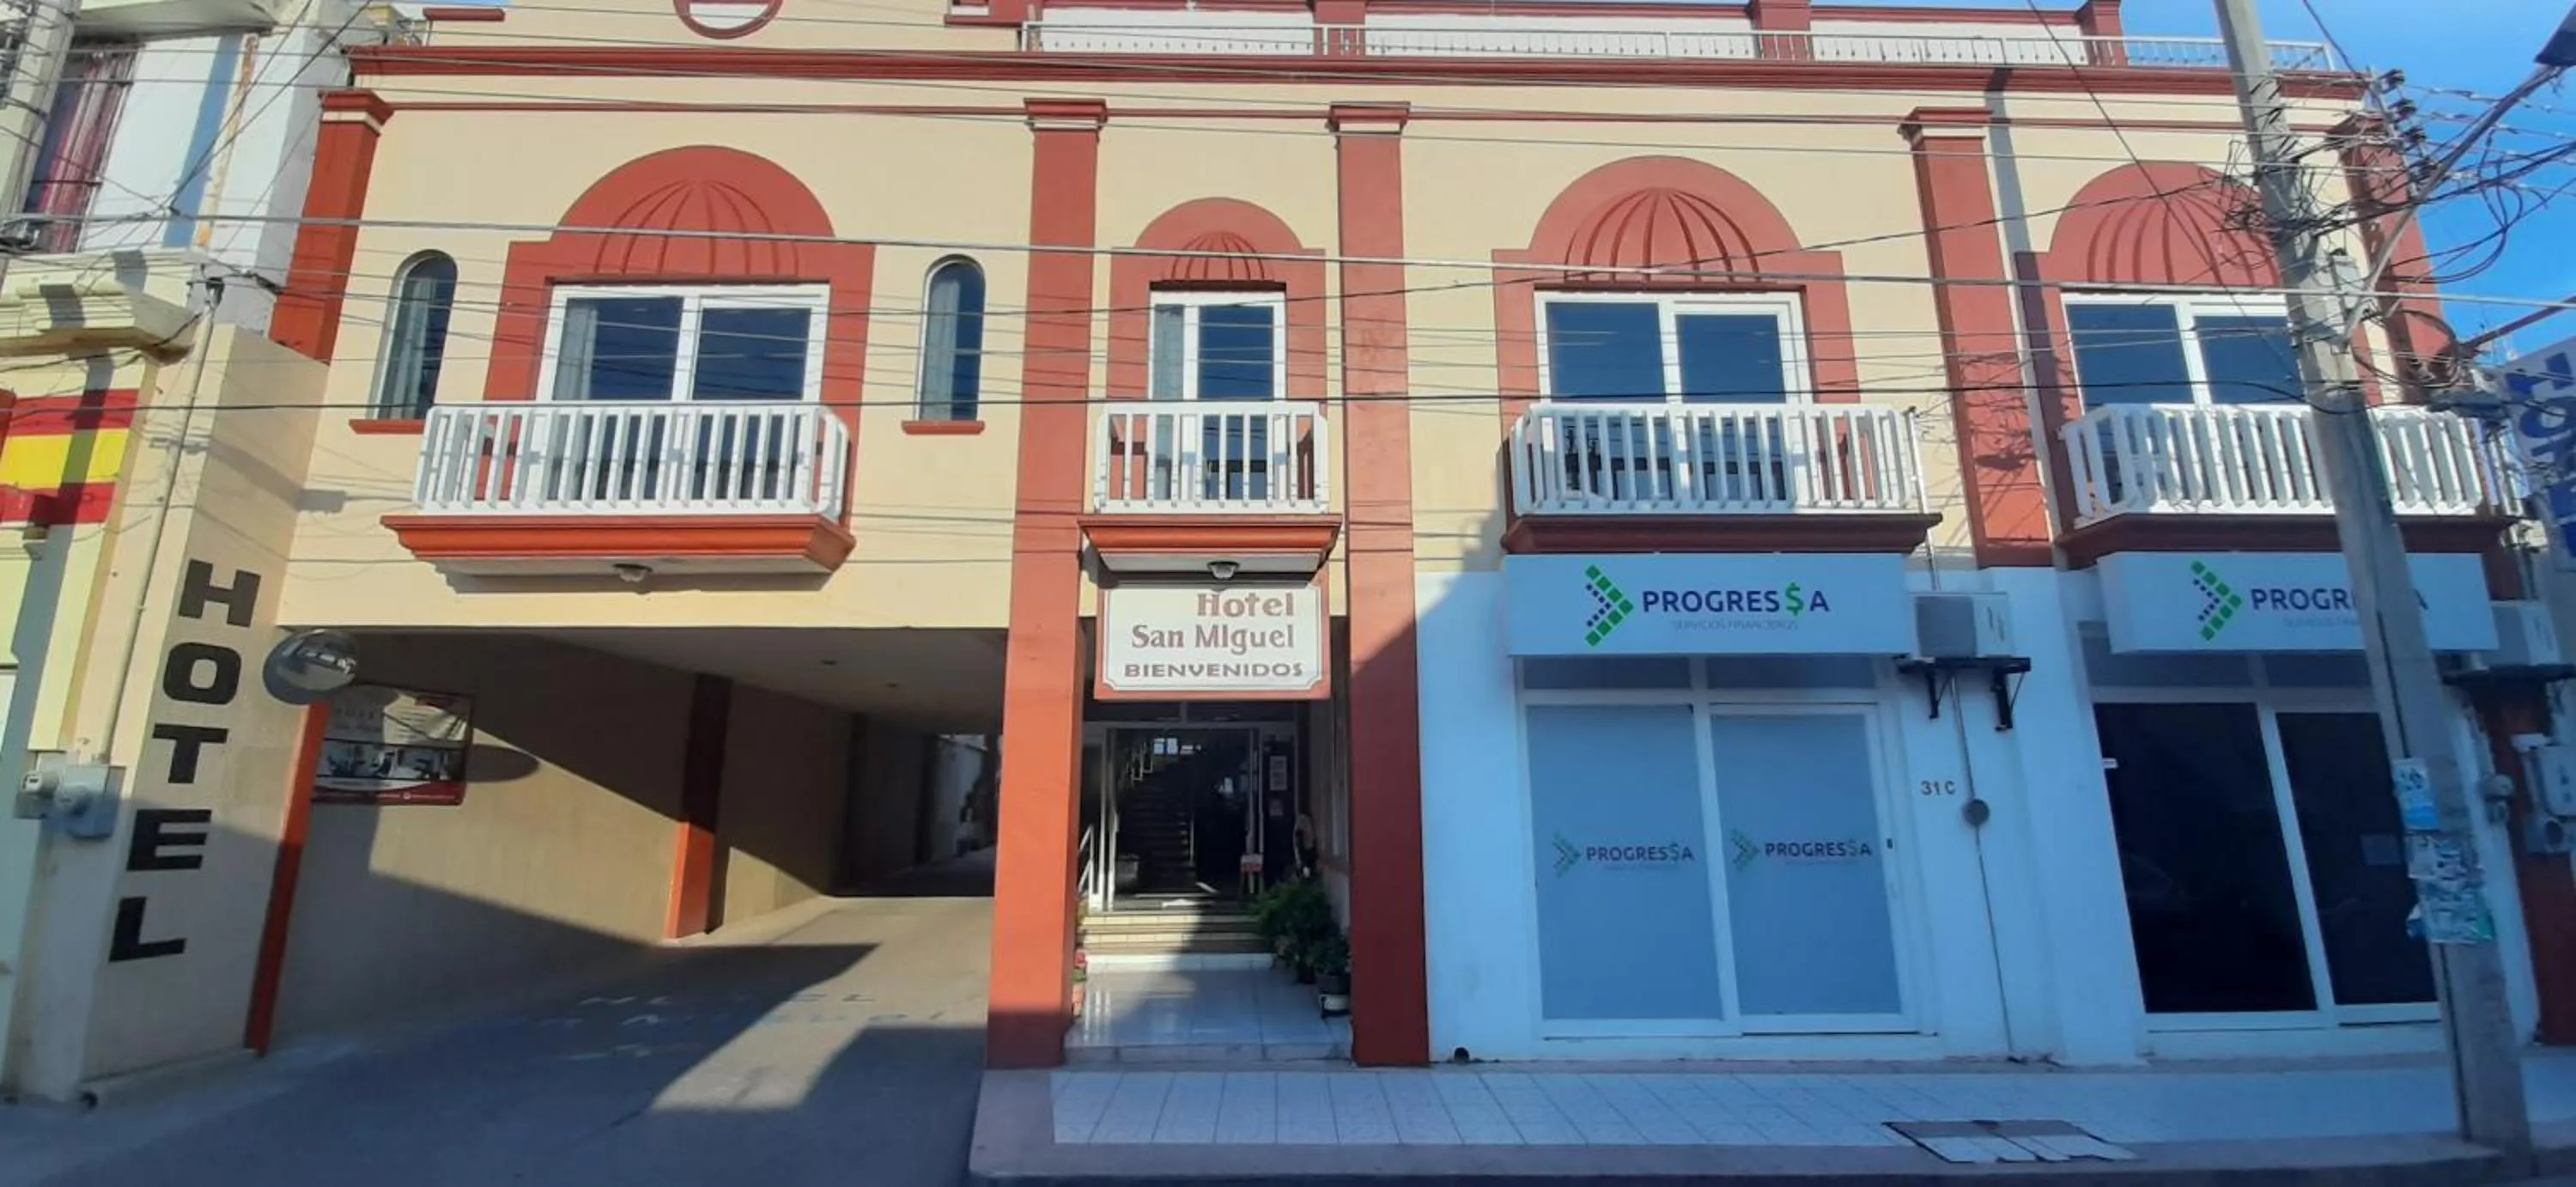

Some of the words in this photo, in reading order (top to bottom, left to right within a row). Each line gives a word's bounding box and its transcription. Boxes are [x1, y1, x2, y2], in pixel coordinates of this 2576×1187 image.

[1196, 592, 1295, 618] Hotel
[1132, 624, 1185, 648] San
[1124, 663, 1303, 678] BIENVENIDOS
[109, 558, 261, 963] HOTEL
[1922, 781, 1941, 795] 31
[1944, 781, 1956, 794] C
